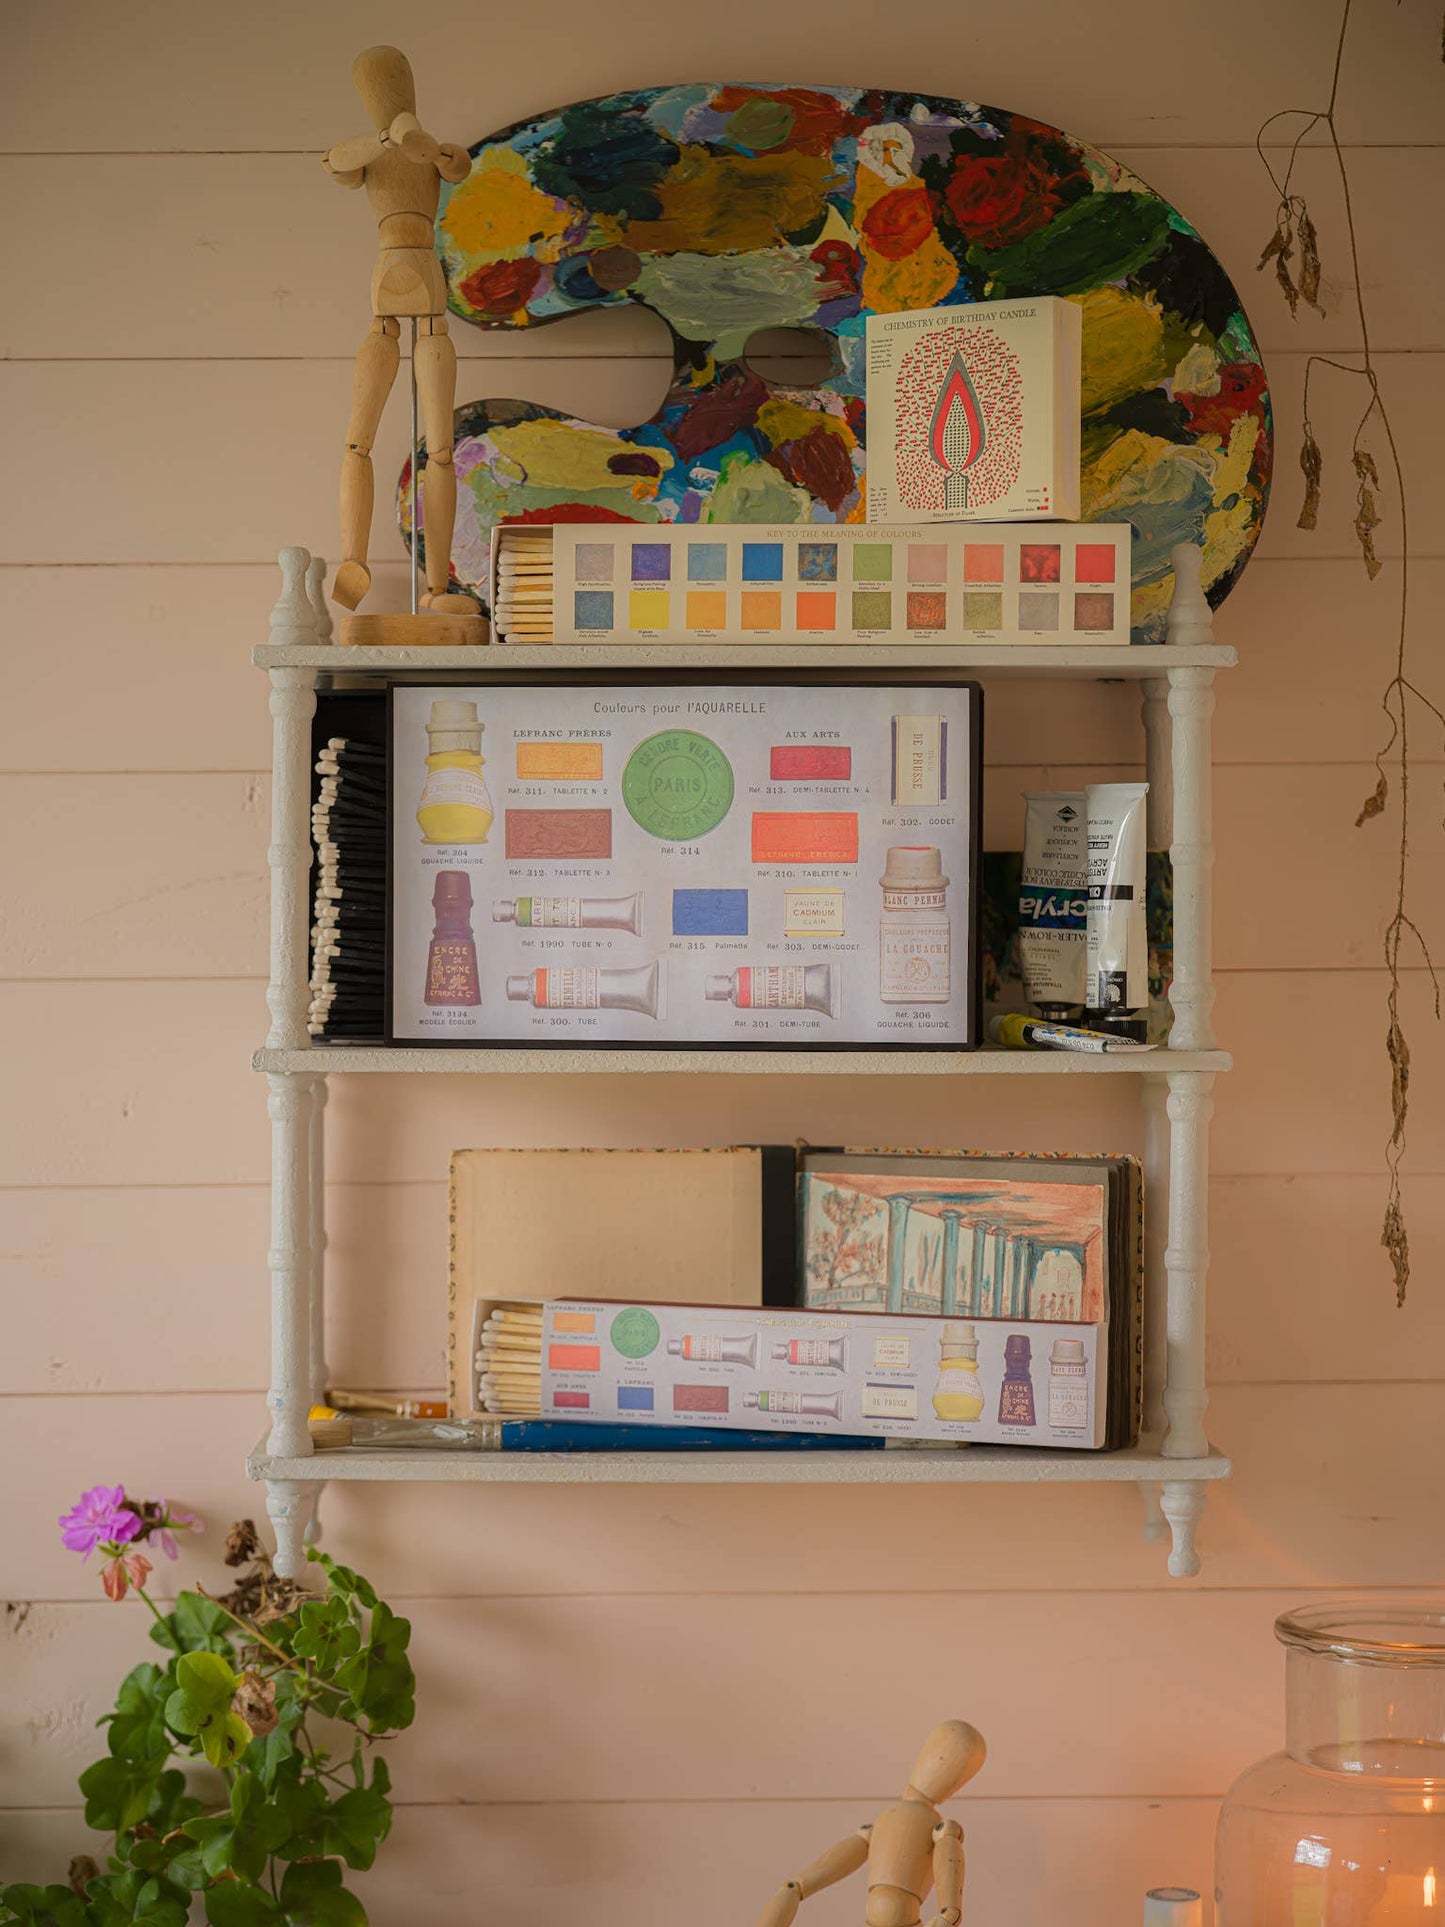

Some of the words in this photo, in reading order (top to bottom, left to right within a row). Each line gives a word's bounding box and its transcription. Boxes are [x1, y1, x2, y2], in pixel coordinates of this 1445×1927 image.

[884, 317, 934, 332] CHEMISTRY
[937, 316, 949, 325] OF
[951, 311, 998, 324] BIRTHDAY
[1000, 308, 1037, 320] CANDLE
[767, 530, 785, 538] KEY
[787, 530, 798, 538] TO
[800, 530, 818, 538] THE
[821, 530, 864, 538] MEANING
[866, 530, 877, 538] OF
[880, 530, 922, 538] COLOURS
[593, 702, 646, 713] Couleurs
[652, 703, 681, 715] pour
[512, 729, 564, 738] LEFRANC
[785, 731, 807, 739] AUX
[812, 731, 841, 739] ARTS
[911, 732, 924, 746] DE
[911, 751, 924, 790] PRUSSE
[654, 777, 701, 792] PARIS
[554, 869, 591, 877] TABLETTE
[1025, 866, 1058, 878] COLOUR
[793, 909, 836, 917] CADMIUM
[539, 940, 565, 948] 1990
[571, 940, 593, 948] TUBE
[434, 946, 469, 954] ENCRE
[886, 944, 898, 954] LA
[902, 944, 949, 954] GOUACHE
[445, 965, 471, 974] CHINE
[912, 1011, 931, 1020] 306
[779, 1020, 821, 1028] DEMI-TUBE
[877, 1021, 914, 1029] GOUACHE
